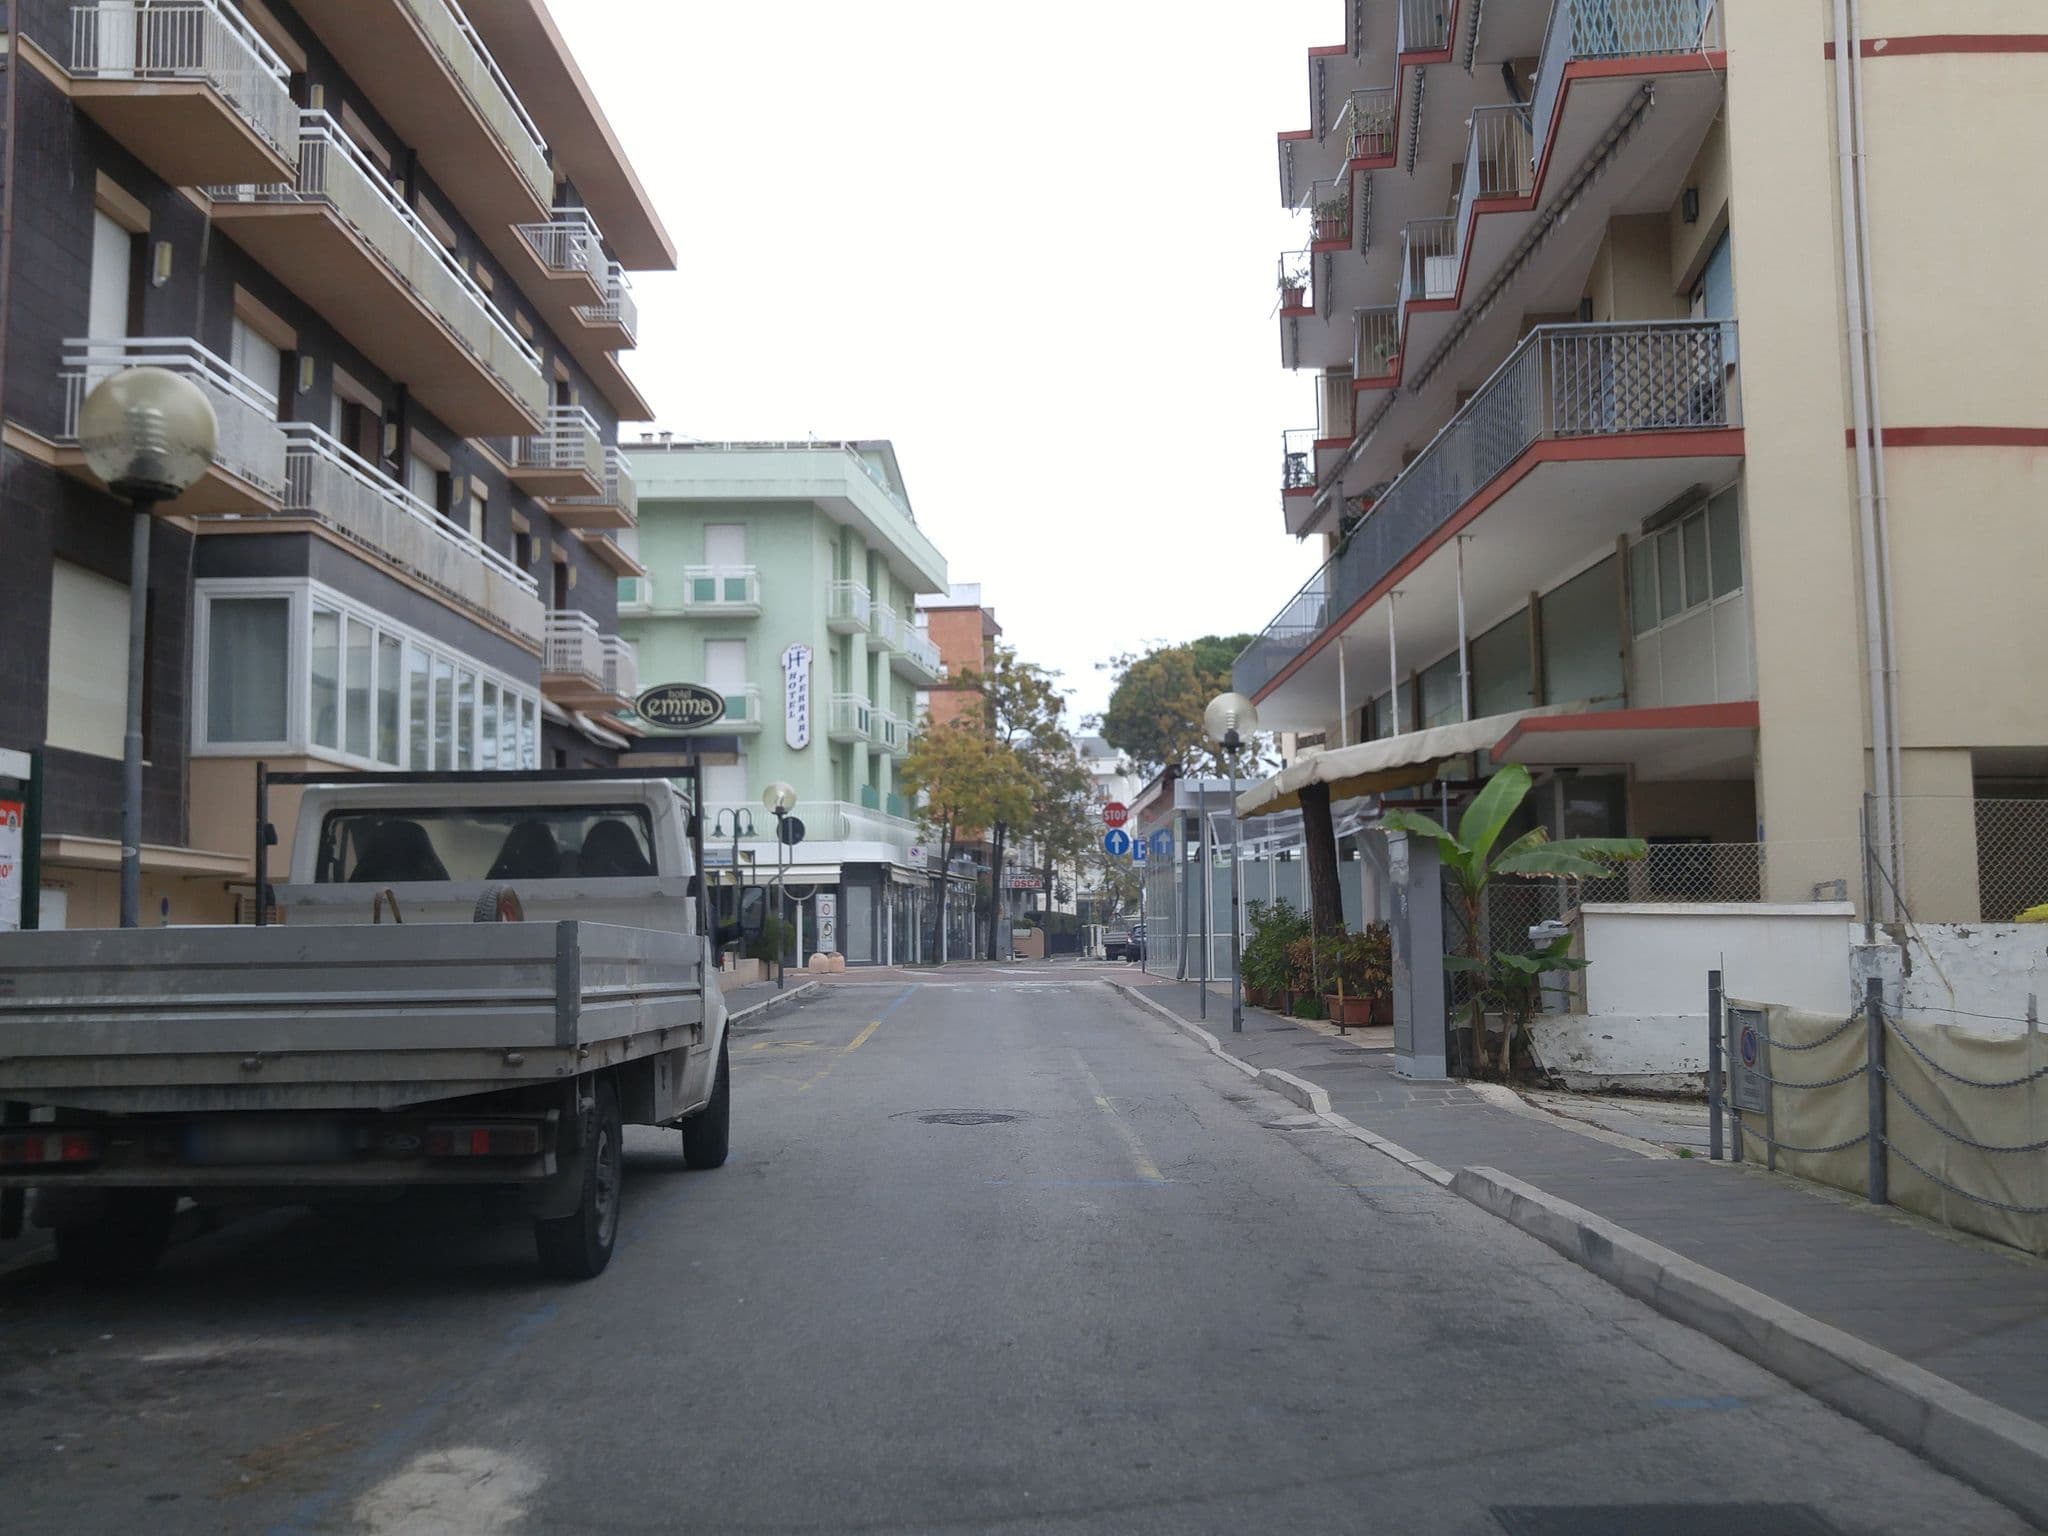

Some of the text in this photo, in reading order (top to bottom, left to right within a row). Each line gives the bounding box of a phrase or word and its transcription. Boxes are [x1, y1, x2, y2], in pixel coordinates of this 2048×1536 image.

[647, 698, 714, 718] emma
[788, 672, 797, 719] HOTEL
[798, 673, 807, 742] FERRARA
[1104, 810, 1127, 820] STOP
